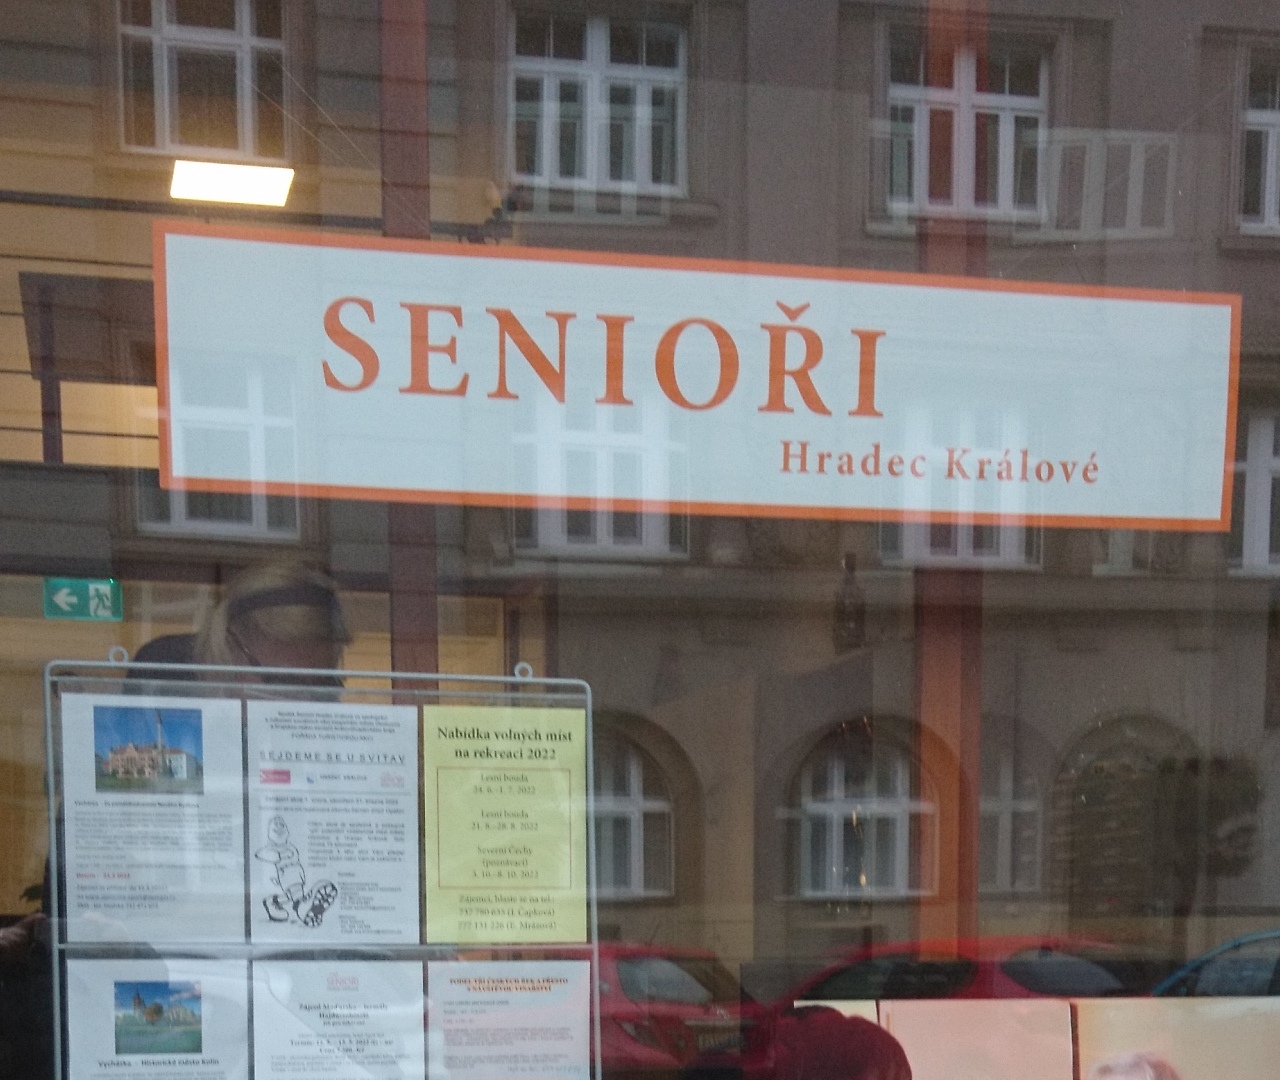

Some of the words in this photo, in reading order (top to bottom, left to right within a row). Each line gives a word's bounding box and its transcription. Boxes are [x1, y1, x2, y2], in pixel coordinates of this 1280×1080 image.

[321, 295, 887, 418] SENIOŘI
[779, 439, 927, 478] Hradec
[945, 446, 1099, 485] Králové
[437, 726, 490, 741] Nabídka
[493, 728, 542, 745] volných
[546, 728, 572, 742] míst
[454, 748, 470, 759] na
[473, 747, 524, 759] rekreaci
[527, 748, 556, 760] 2022
